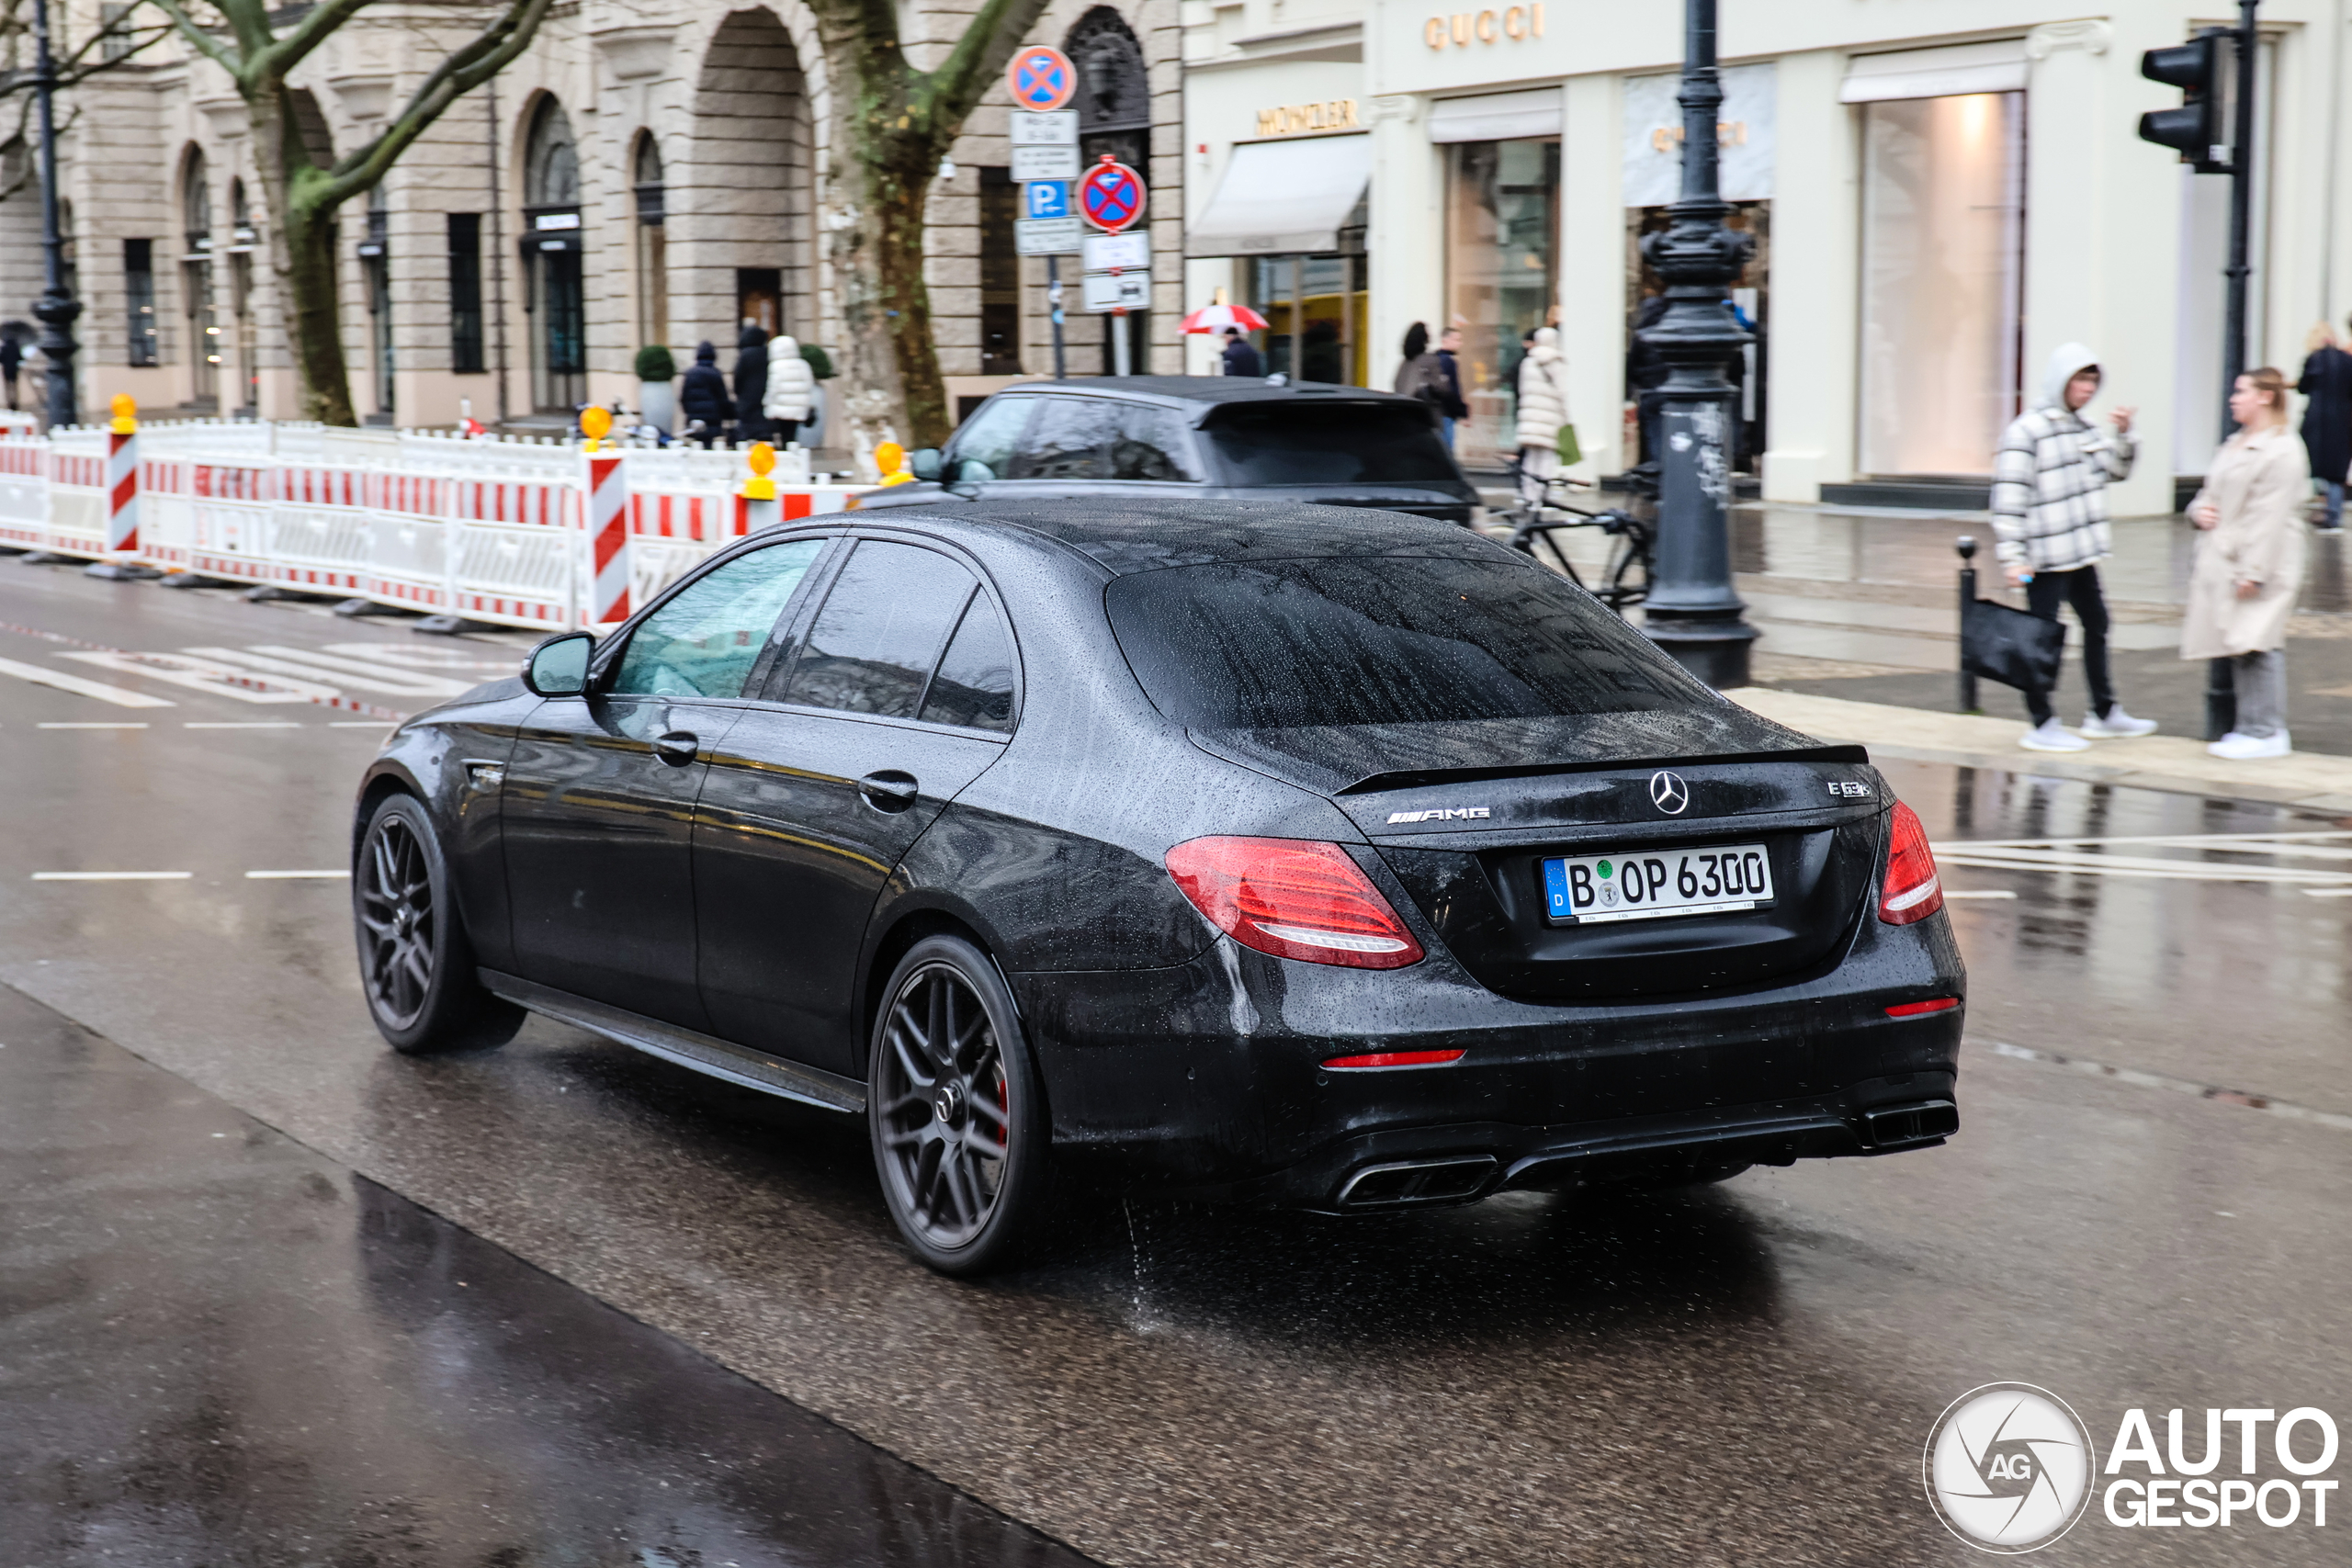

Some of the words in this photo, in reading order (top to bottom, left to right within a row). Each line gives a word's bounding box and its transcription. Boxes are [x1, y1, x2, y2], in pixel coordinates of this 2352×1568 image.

[1424, 3, 1544, 52] GUCCI
[1032, 185, 1057, 214] P
[1828, 782, 1840, 795] E
[1420, 807, 1490, 823] AMG
[1569, 864, 1595, 908] B
[1621, 859, 1667, 903] OP
[1678, 852, 1765, 898] 6300
[1555, 894, 1564, 907] D
